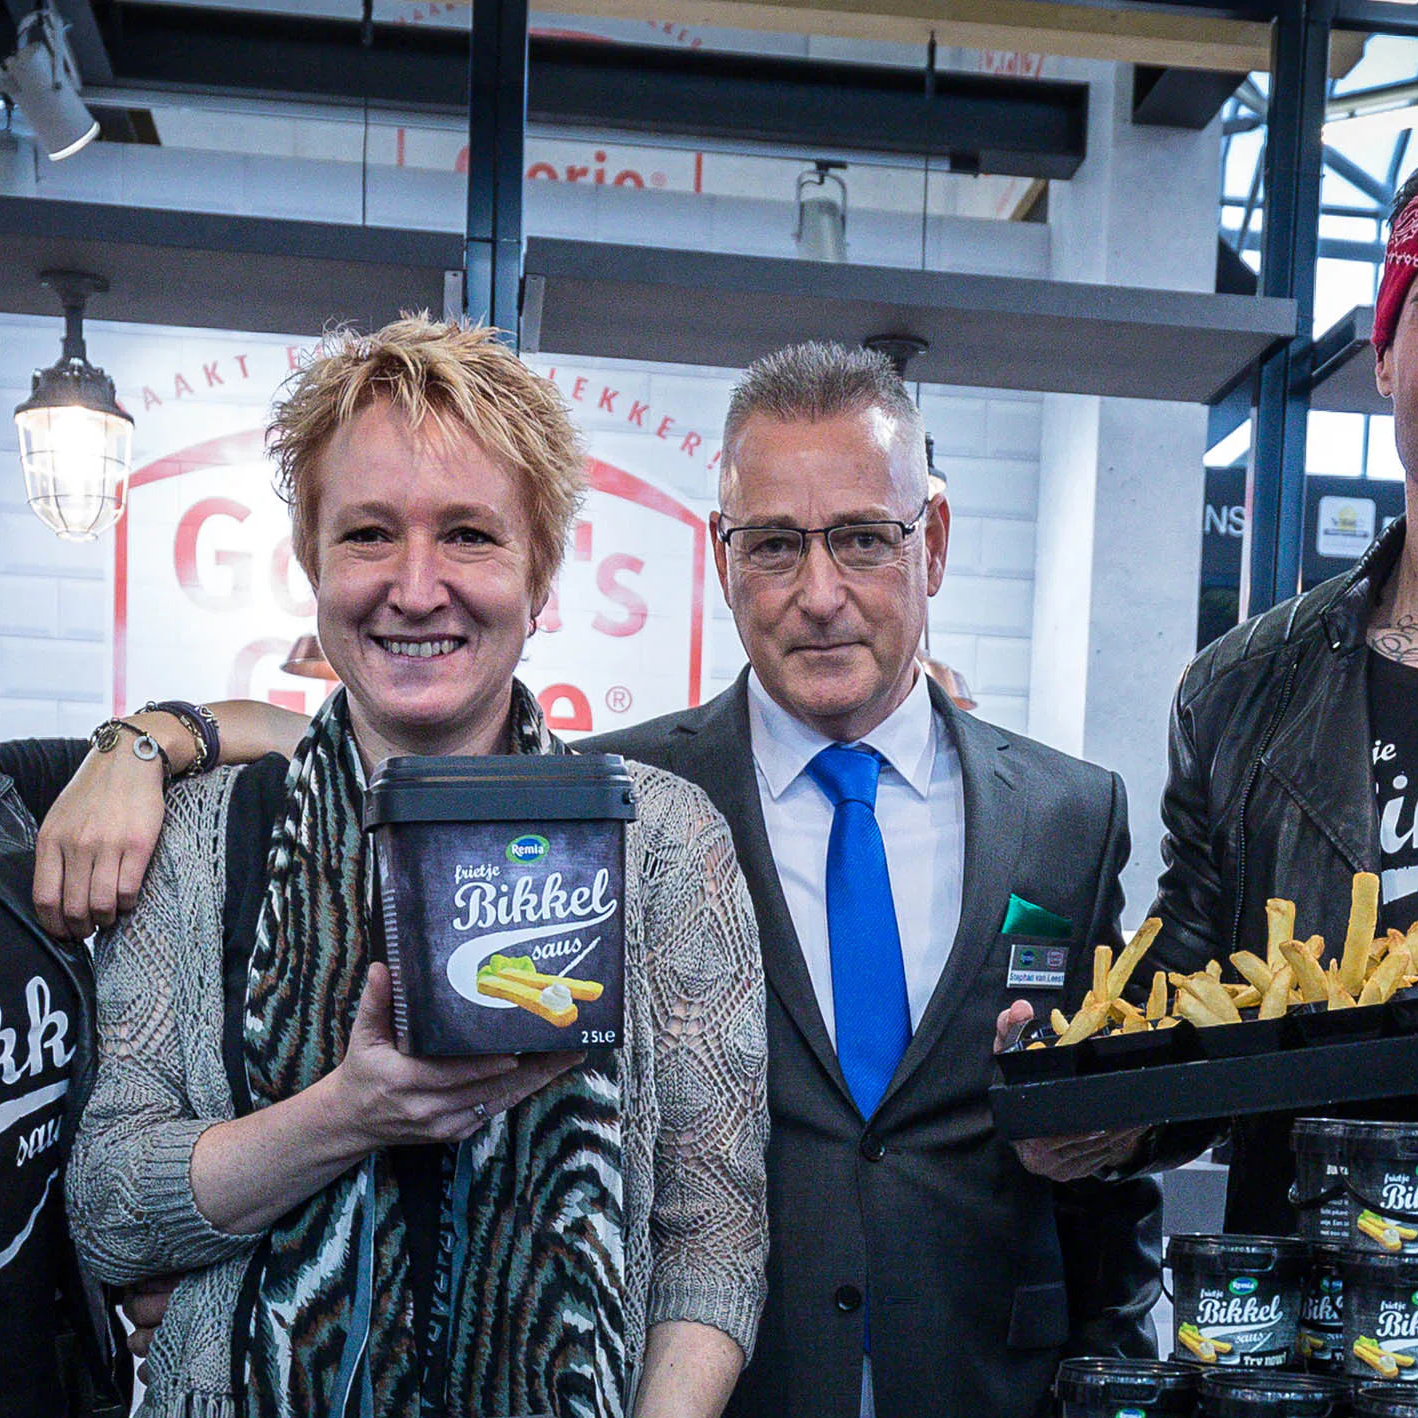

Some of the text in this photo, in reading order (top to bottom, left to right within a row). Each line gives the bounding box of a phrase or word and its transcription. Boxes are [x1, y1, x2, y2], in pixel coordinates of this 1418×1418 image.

[454, 864, 501, 885] frietje
[452, 868, 618, 931] Bikkel
[532, 937, 583, 961] saus
[1196, 1295, 1283, 1324] Bikkel
